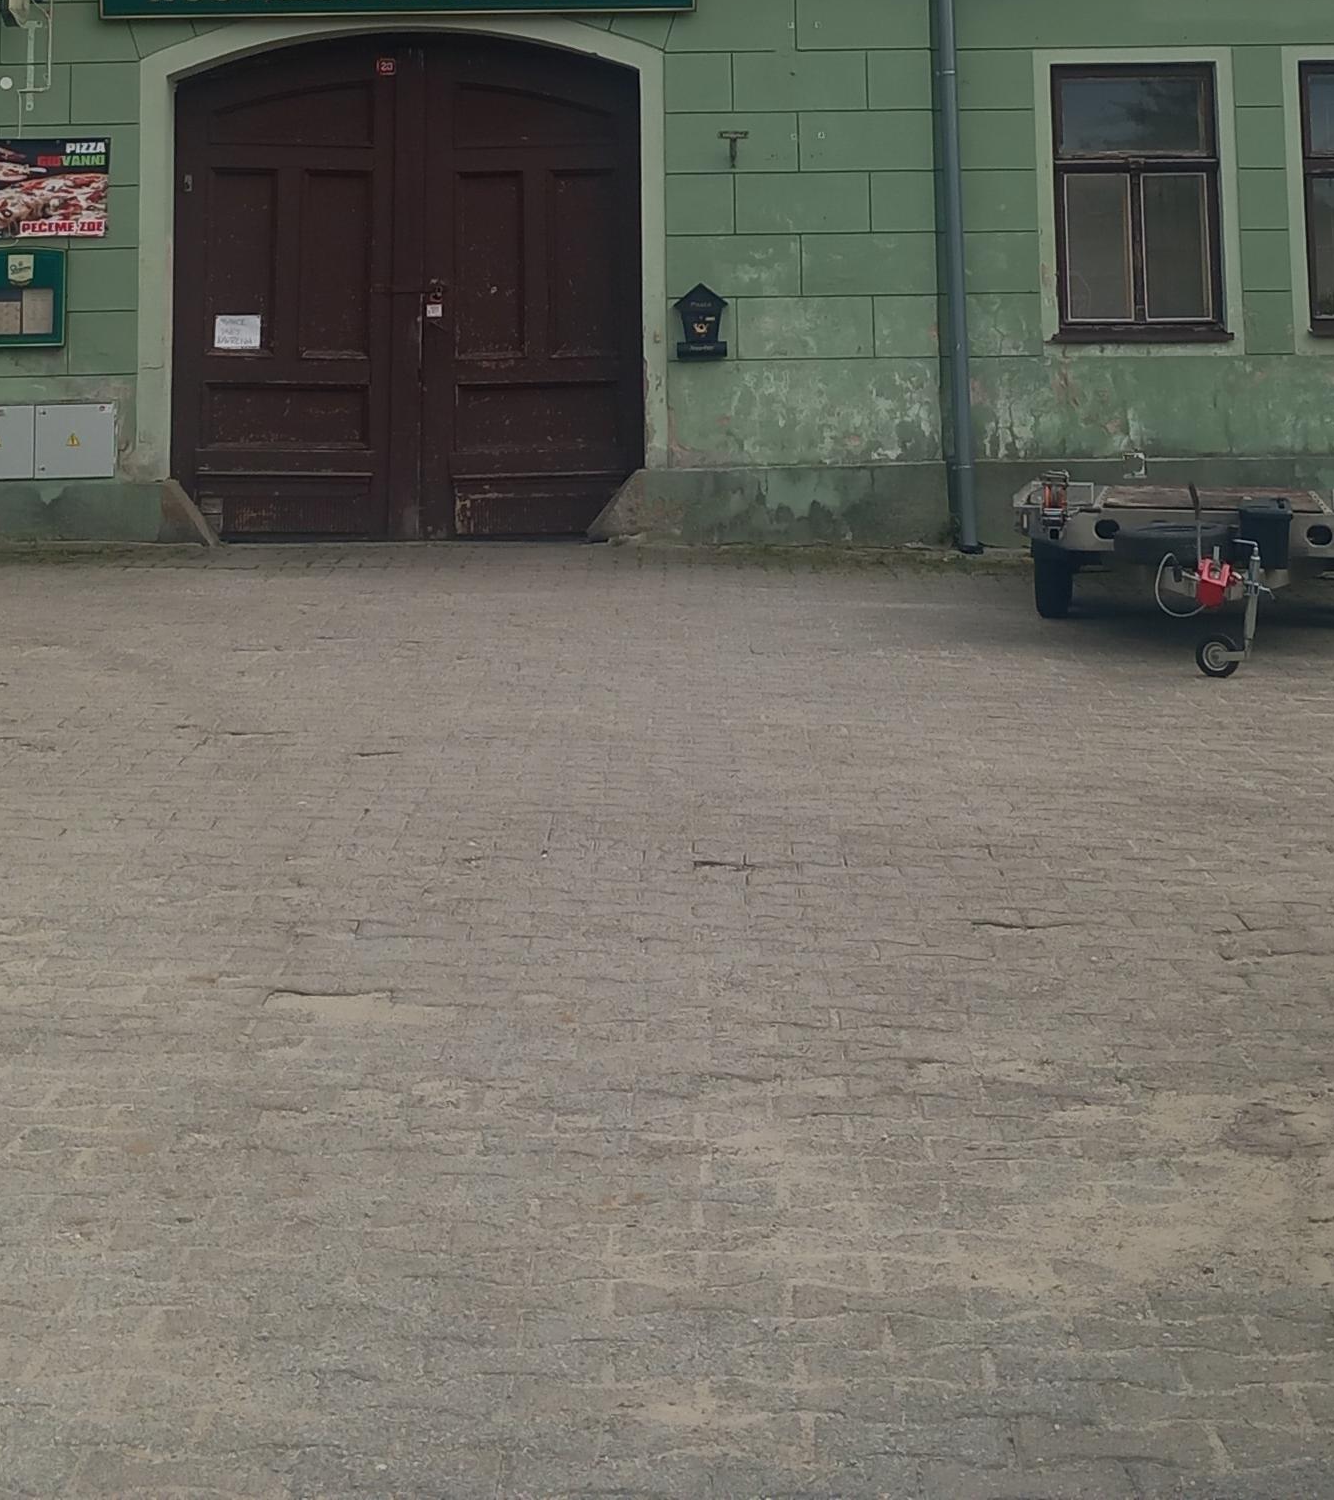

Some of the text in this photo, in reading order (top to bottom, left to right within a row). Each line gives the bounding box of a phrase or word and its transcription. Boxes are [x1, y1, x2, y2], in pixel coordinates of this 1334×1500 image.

[65, 142, 106, 154] PIZZA
[21, 221, 104, 233] PEČEME ZDE
